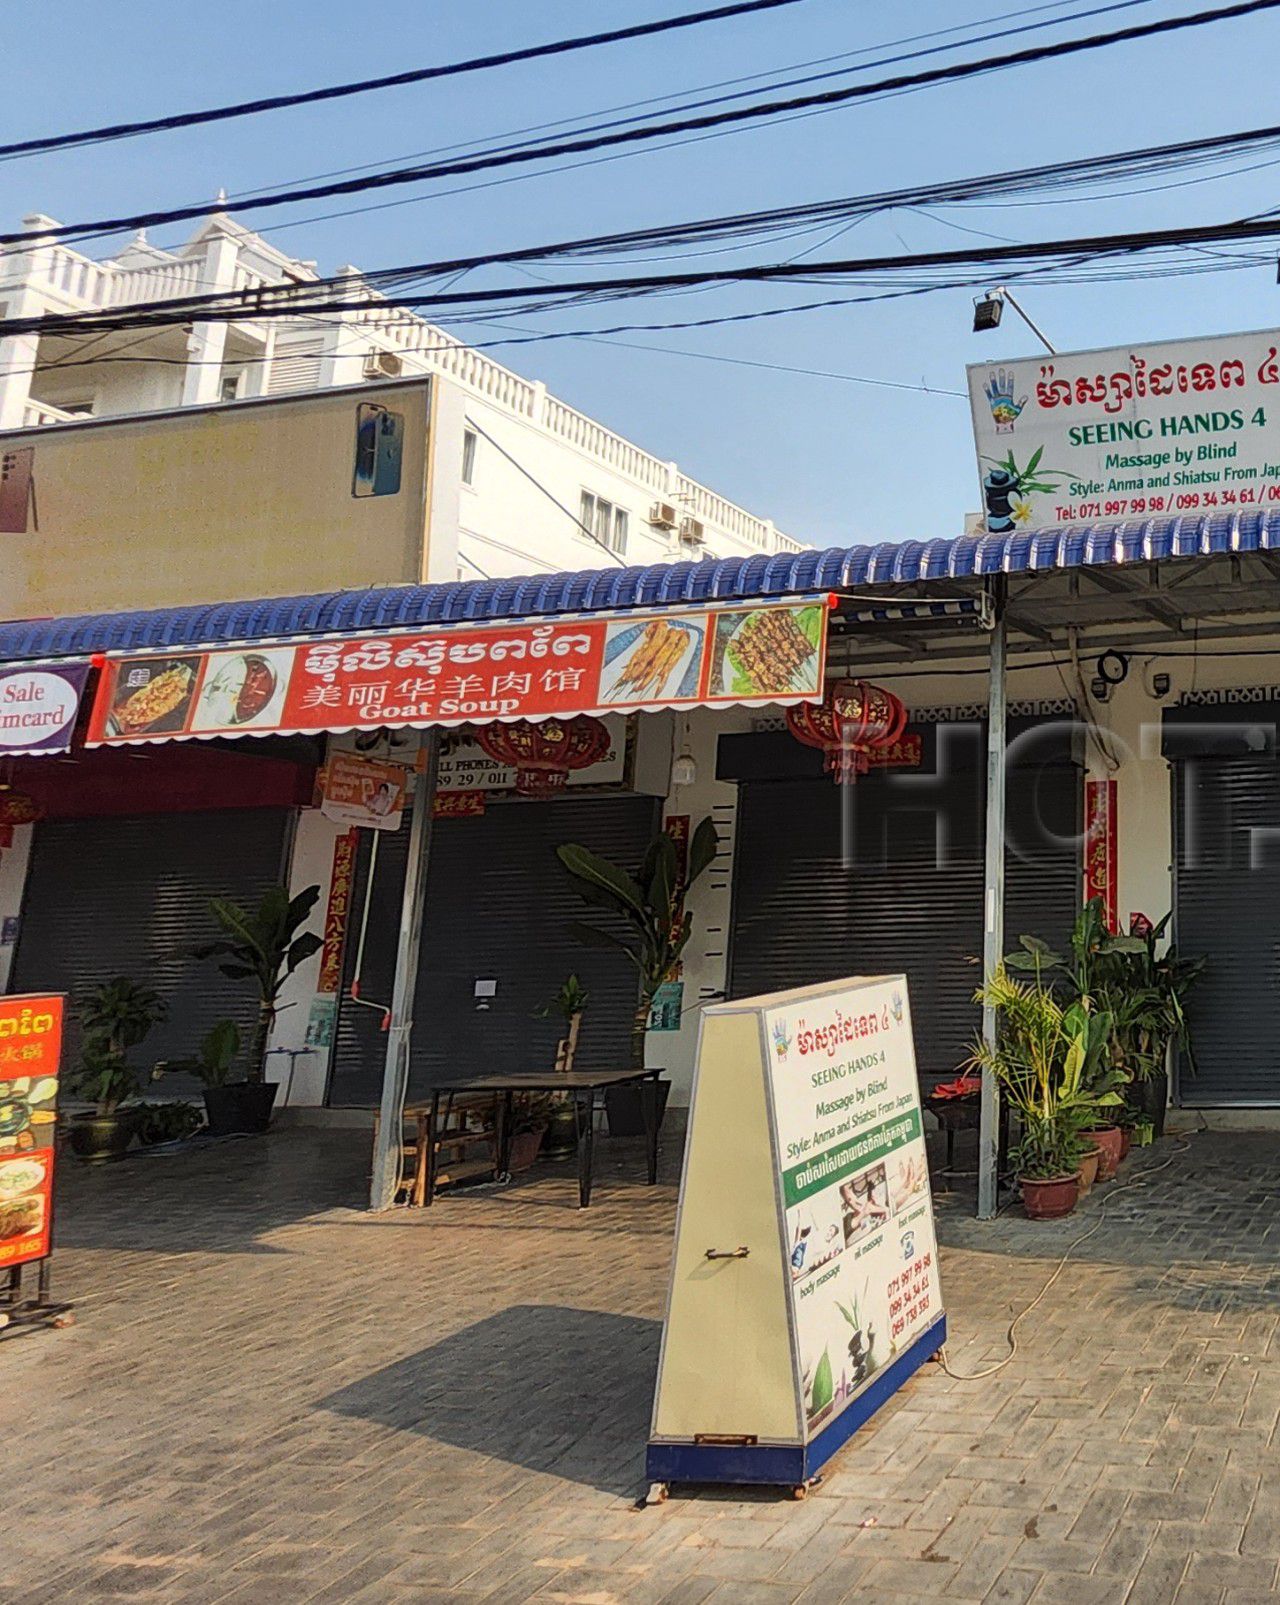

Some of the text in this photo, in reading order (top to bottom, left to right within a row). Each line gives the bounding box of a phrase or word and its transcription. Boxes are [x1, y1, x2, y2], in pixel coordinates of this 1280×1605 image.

[1257, 347, 1280, 384] ៤
[1068, 407, 1267, 446] SEEING HANDS 4
[1105, 441, 1237, 470] Massage by Blind
[1069, 480, 1104, 498] Style:
[1107, 478, 1144, 492] Anma
[1146, 472, 1170, 488] and
[1173, 468, 1220, 486] Shiatsu
[1224, 466, 1257, 480] From
[1055, 504, 1077, 520] Tel:
[1079, 503, 1101, 518] 071
[1105, 500, 1127, 516] 997
[1130, 498, 1146, 513] 99
[1148, 497, 1164, 511] 98
[1166, 493, 1175, 512] /
[1176, 493, 1200, 509] 099
[1202, 491, 1218, 507] 34
[1221, 490, 1237, 505] 34
[1240, 488, 1256, 503] 61
[1257, 484, 1266, 504] /
[3, 681, 45, 703] Sale
[299, 667, 586, 709] 美丽华羊肉馆
[359, 698, 520, 720] Goat Soup
[456, 759, 499, 771] PHONES
[457, 774, 474, 786] 29
[881, 1004, 889, 1030] ៤
[811, 1050, 886, 1088] SEEING HANDS 4
[815, 1076, 888, 1119] Massage by Blind
[786, 1093, 913, 1160] Style: Anma and Shiatsu From Japan
[887, 1276, 900, 1298] 071
[901, 1266, 913, 1287] 997
[914, 1260, 922, 1277] 99
[889, 1297, 902, 1318] 099
[903, 1290, 911, 1306] 34
[912, 1282, 921, 1299] 34
[891, 1317, 905, 1339] 069
[906, 1303, 918, 1325] 738
